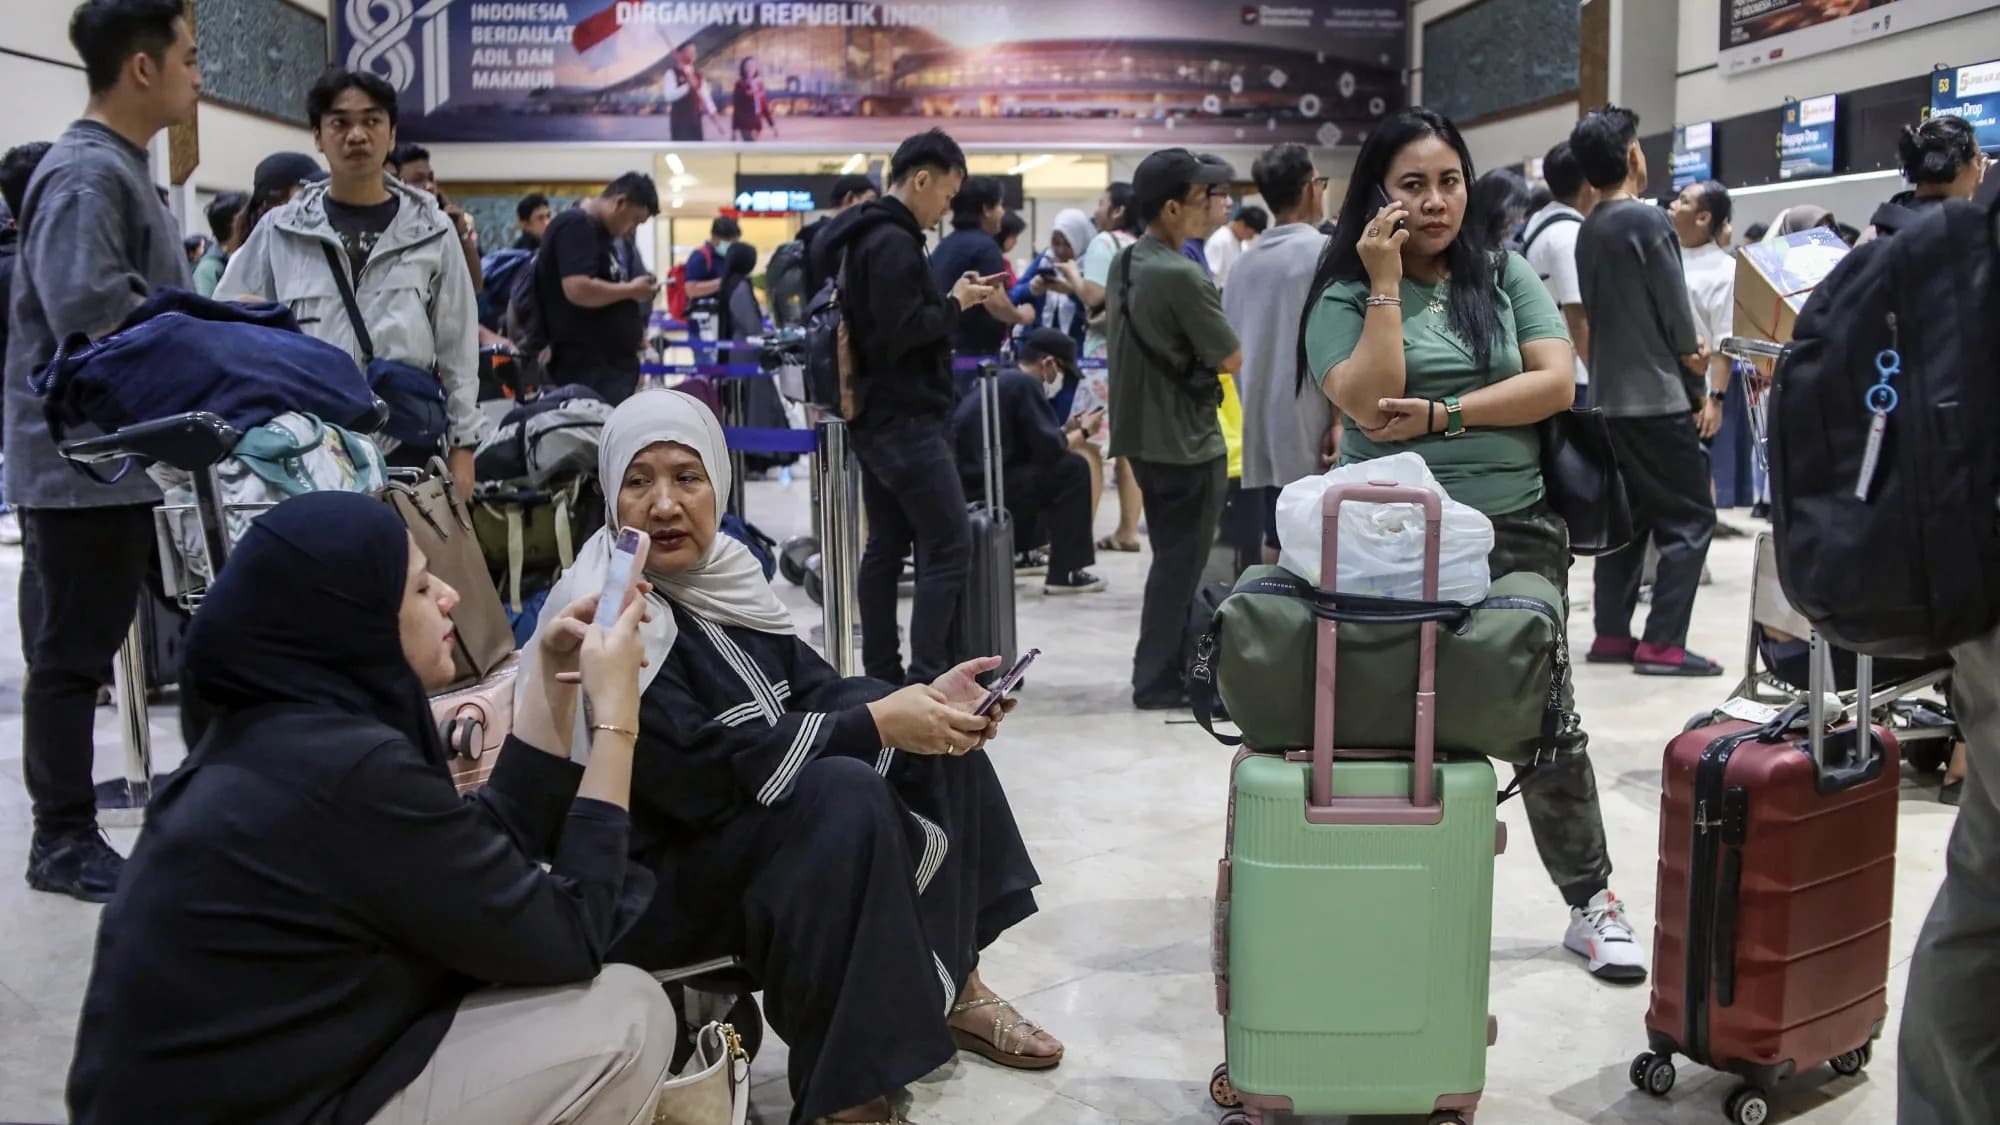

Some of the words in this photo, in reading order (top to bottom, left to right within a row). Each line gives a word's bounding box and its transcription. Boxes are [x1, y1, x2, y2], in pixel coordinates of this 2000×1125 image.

[471, 3, 569, 20] INDONESIA
[615, 2, 755, 25] DIRGAHAYU
[760, 3, 876, 26] REPUBLIK
[472, 26, 576, 43] BERDAULAT
[472, 48, 512, 66] ADIL
[516, 48, 554, 66] DAN
[472, 70, 554, 88] MAKMUR
[1963, 102, 1983, 119] Drop
